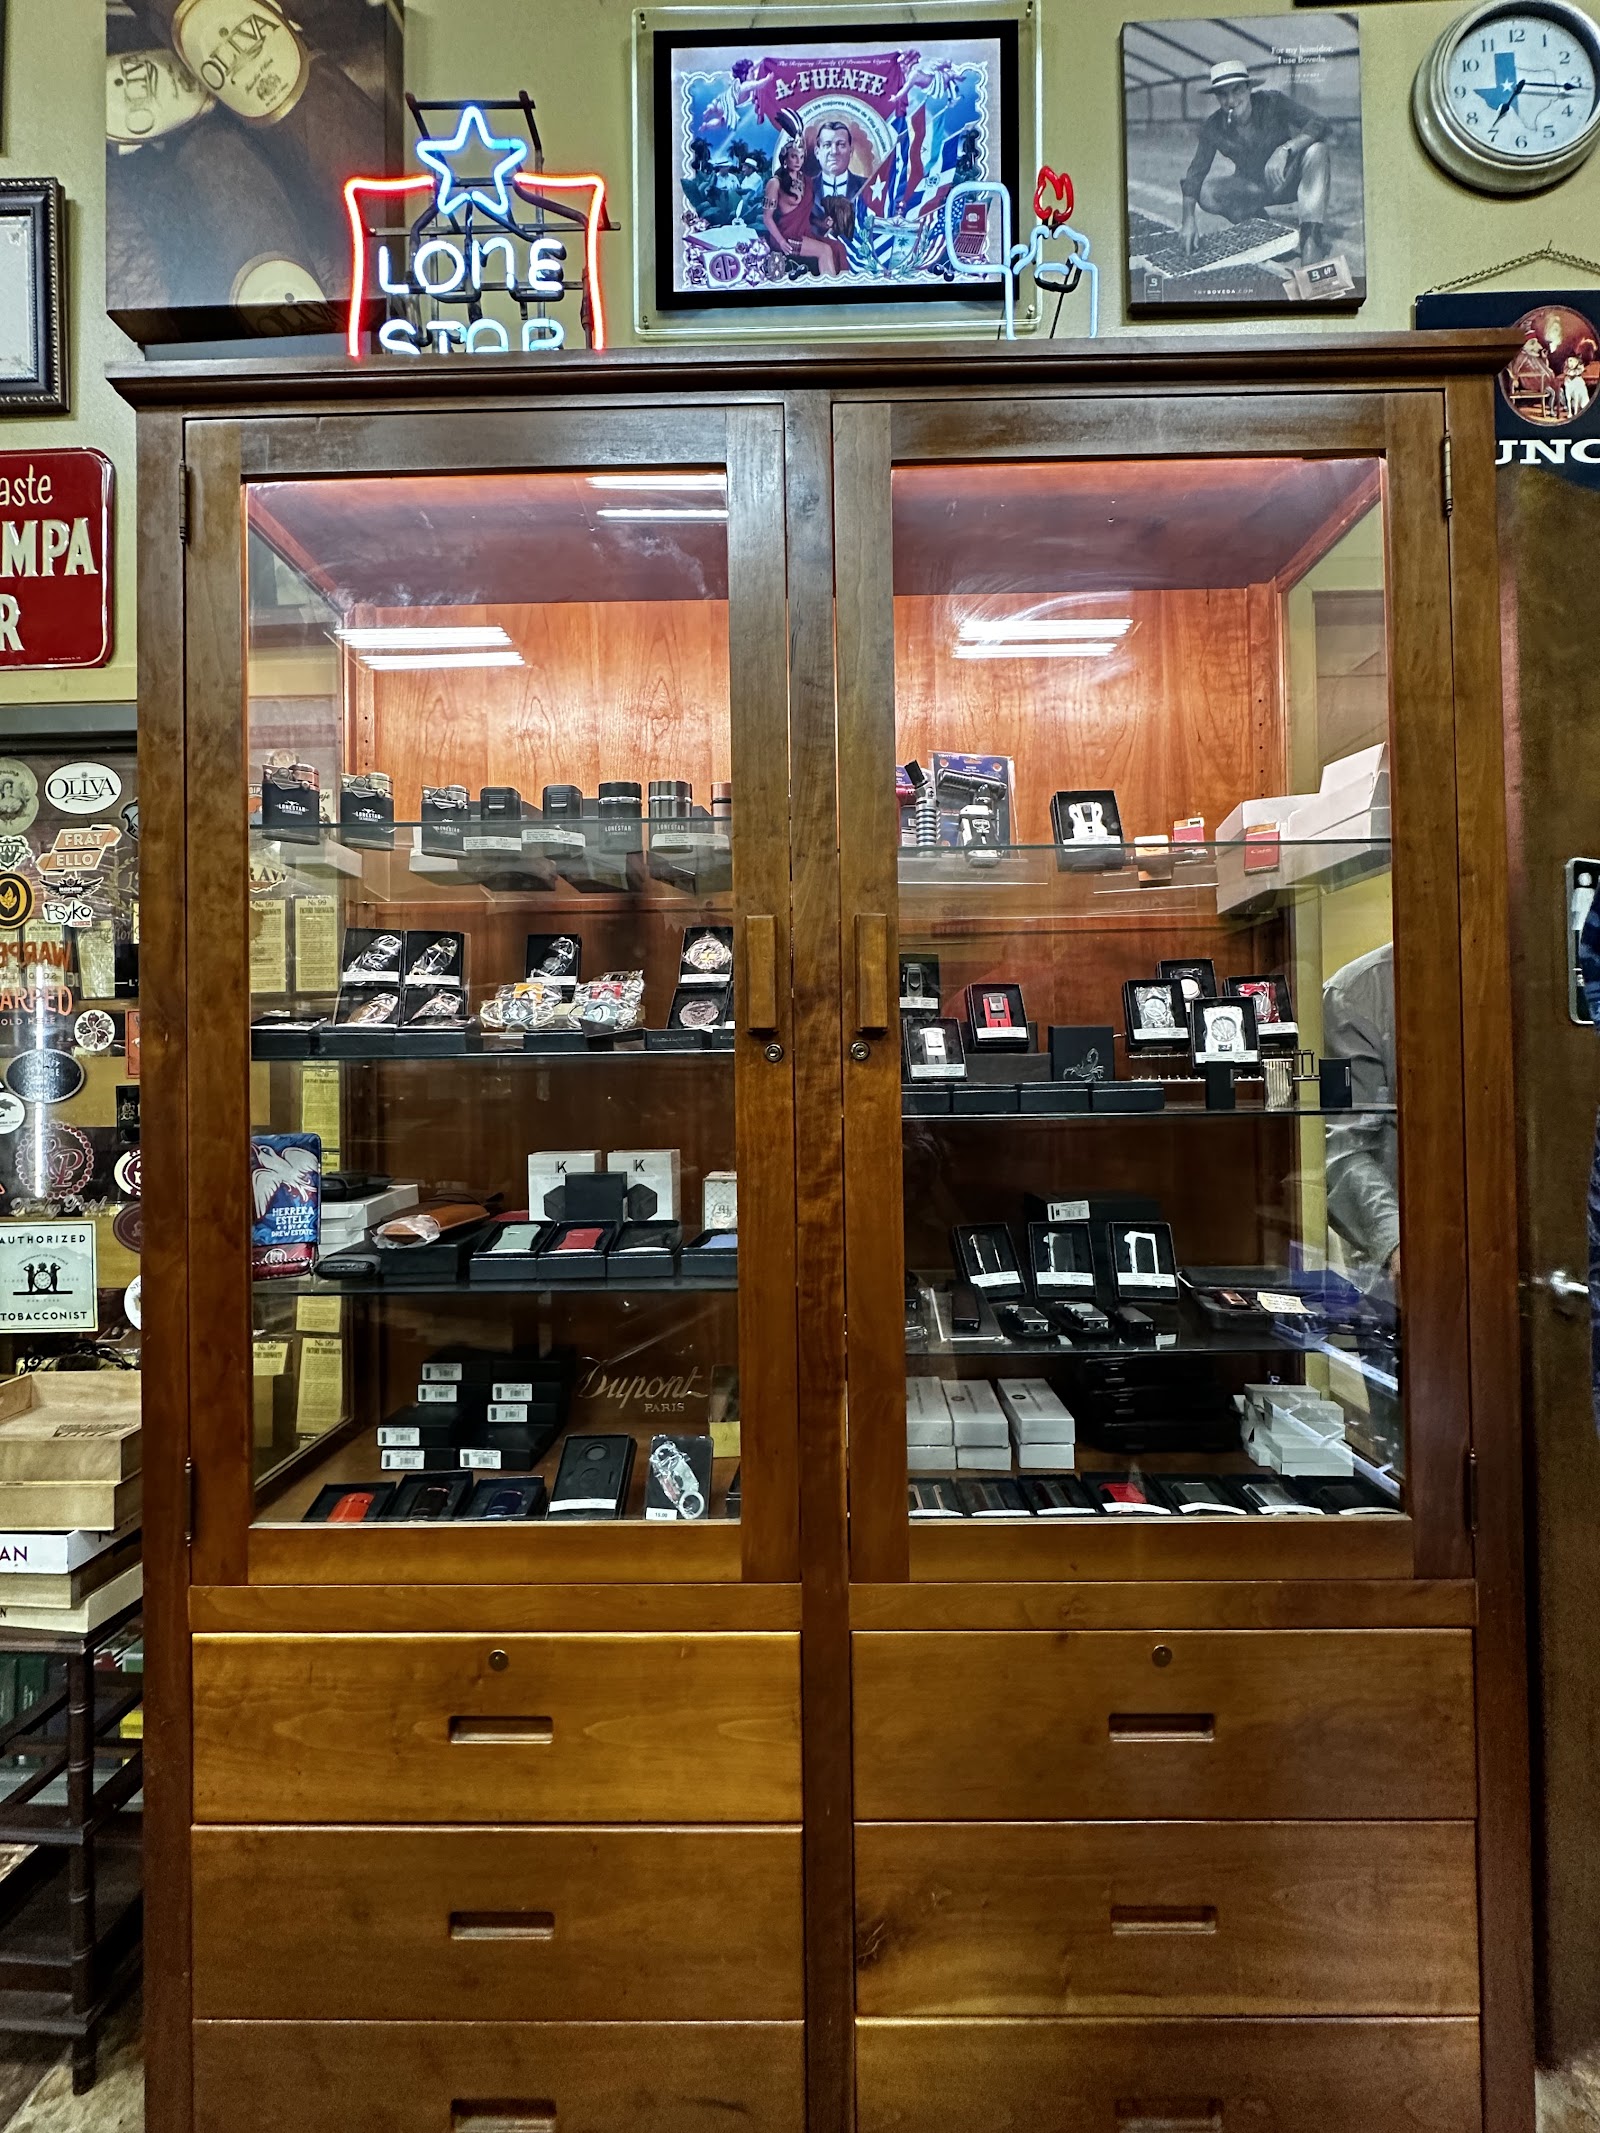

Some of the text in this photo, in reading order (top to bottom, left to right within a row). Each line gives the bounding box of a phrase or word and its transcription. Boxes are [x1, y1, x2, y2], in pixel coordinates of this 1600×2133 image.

[1509, 29, 1525, 42] 12
[1542, 33, 1547, 47] 1
[201, 14, 280, 90] OLIVA
[1482, 39, 1494, 52] 11
[1559, 51, 1570, 64] 2
[1462, 59, 1479, 73] 10
[797, 67, 887, 97] FUENTE
[1454, 86, 1466, 99] 9
[1561, 105, 1573, 117] 4
[1466, 112, 1478, 125] 8
[1488, 130, 1498, 142] 7
[1543, 125, 1555, 139] 5
[1515, 135, 1528, 149] 6
[378, 238, 564, 294] LONE
[0, 517, 99, 577] MPA
[47, 777, 117, 800] OLIVA
[64, 833, 102, 846] FRAT
[56, 853, 94, 867] ELLO
[554, 1160, 568, 1173] K
[633, 1159, 646, 1173] K
[272, 1206, 315, 1216] HERRERA
[0, 1235, 86, 1244] AUTHORIZED
[0, 1311, 87, 1321] TOBACCONIST
[578, 1356, 708, 1409] Dupont
[644, 1402, 685, 1412] PARIS
[0, 1546, 27, 1562] AN
